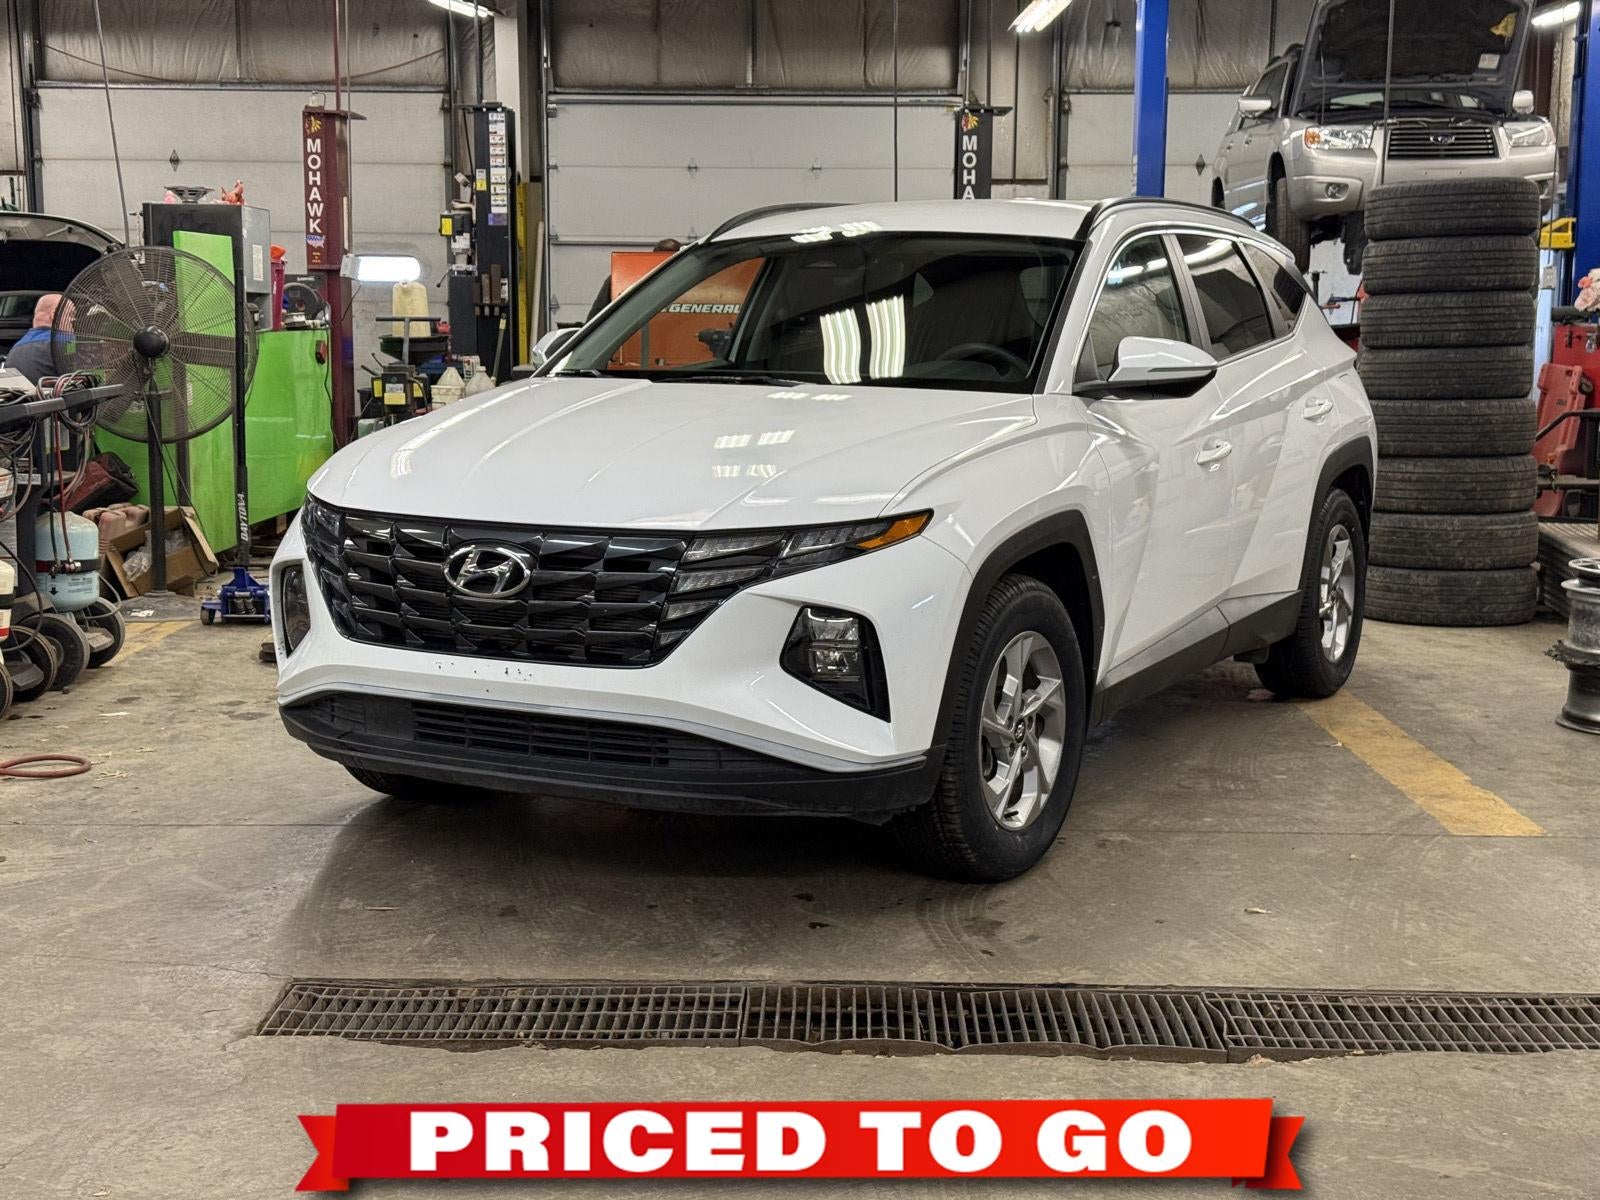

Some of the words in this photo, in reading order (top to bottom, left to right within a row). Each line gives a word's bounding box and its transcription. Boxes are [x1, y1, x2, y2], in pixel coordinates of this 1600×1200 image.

[306, 138, 324, 233] MOHAWK
[668, 303, 740, 313] GENERAL
[237, 492, 249, 542] DAYTONA
